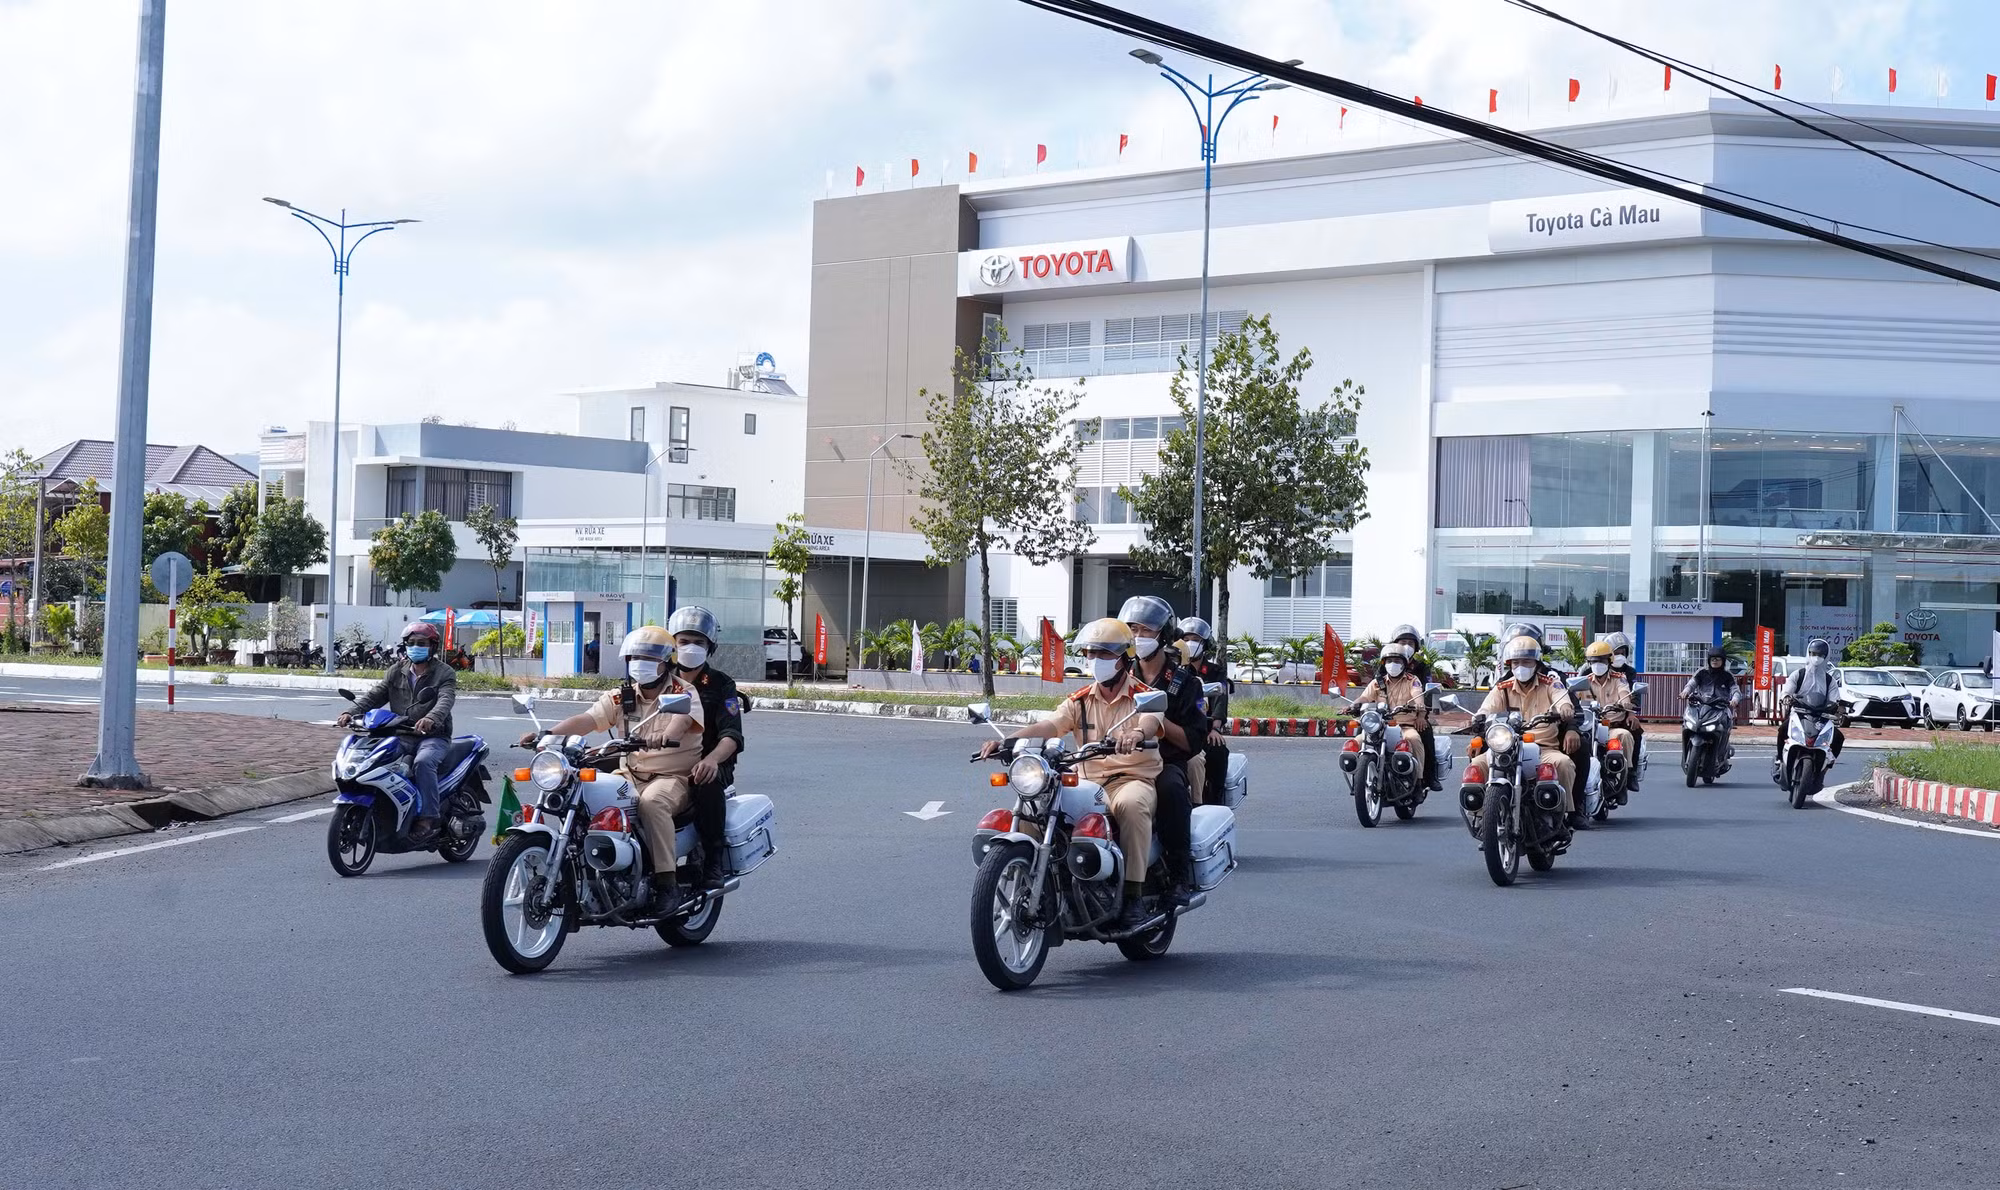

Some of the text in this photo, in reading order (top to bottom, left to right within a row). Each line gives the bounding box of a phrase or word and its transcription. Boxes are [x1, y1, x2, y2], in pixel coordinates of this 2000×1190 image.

[1526, 204, 1660, 236] Toyota Cà Mau
[1019, 249, 1114, 279] TOYOTA
[1904, 633, 1940, 641] TOYOTA
[1331, 655, 1341, 678] TOYOTA
